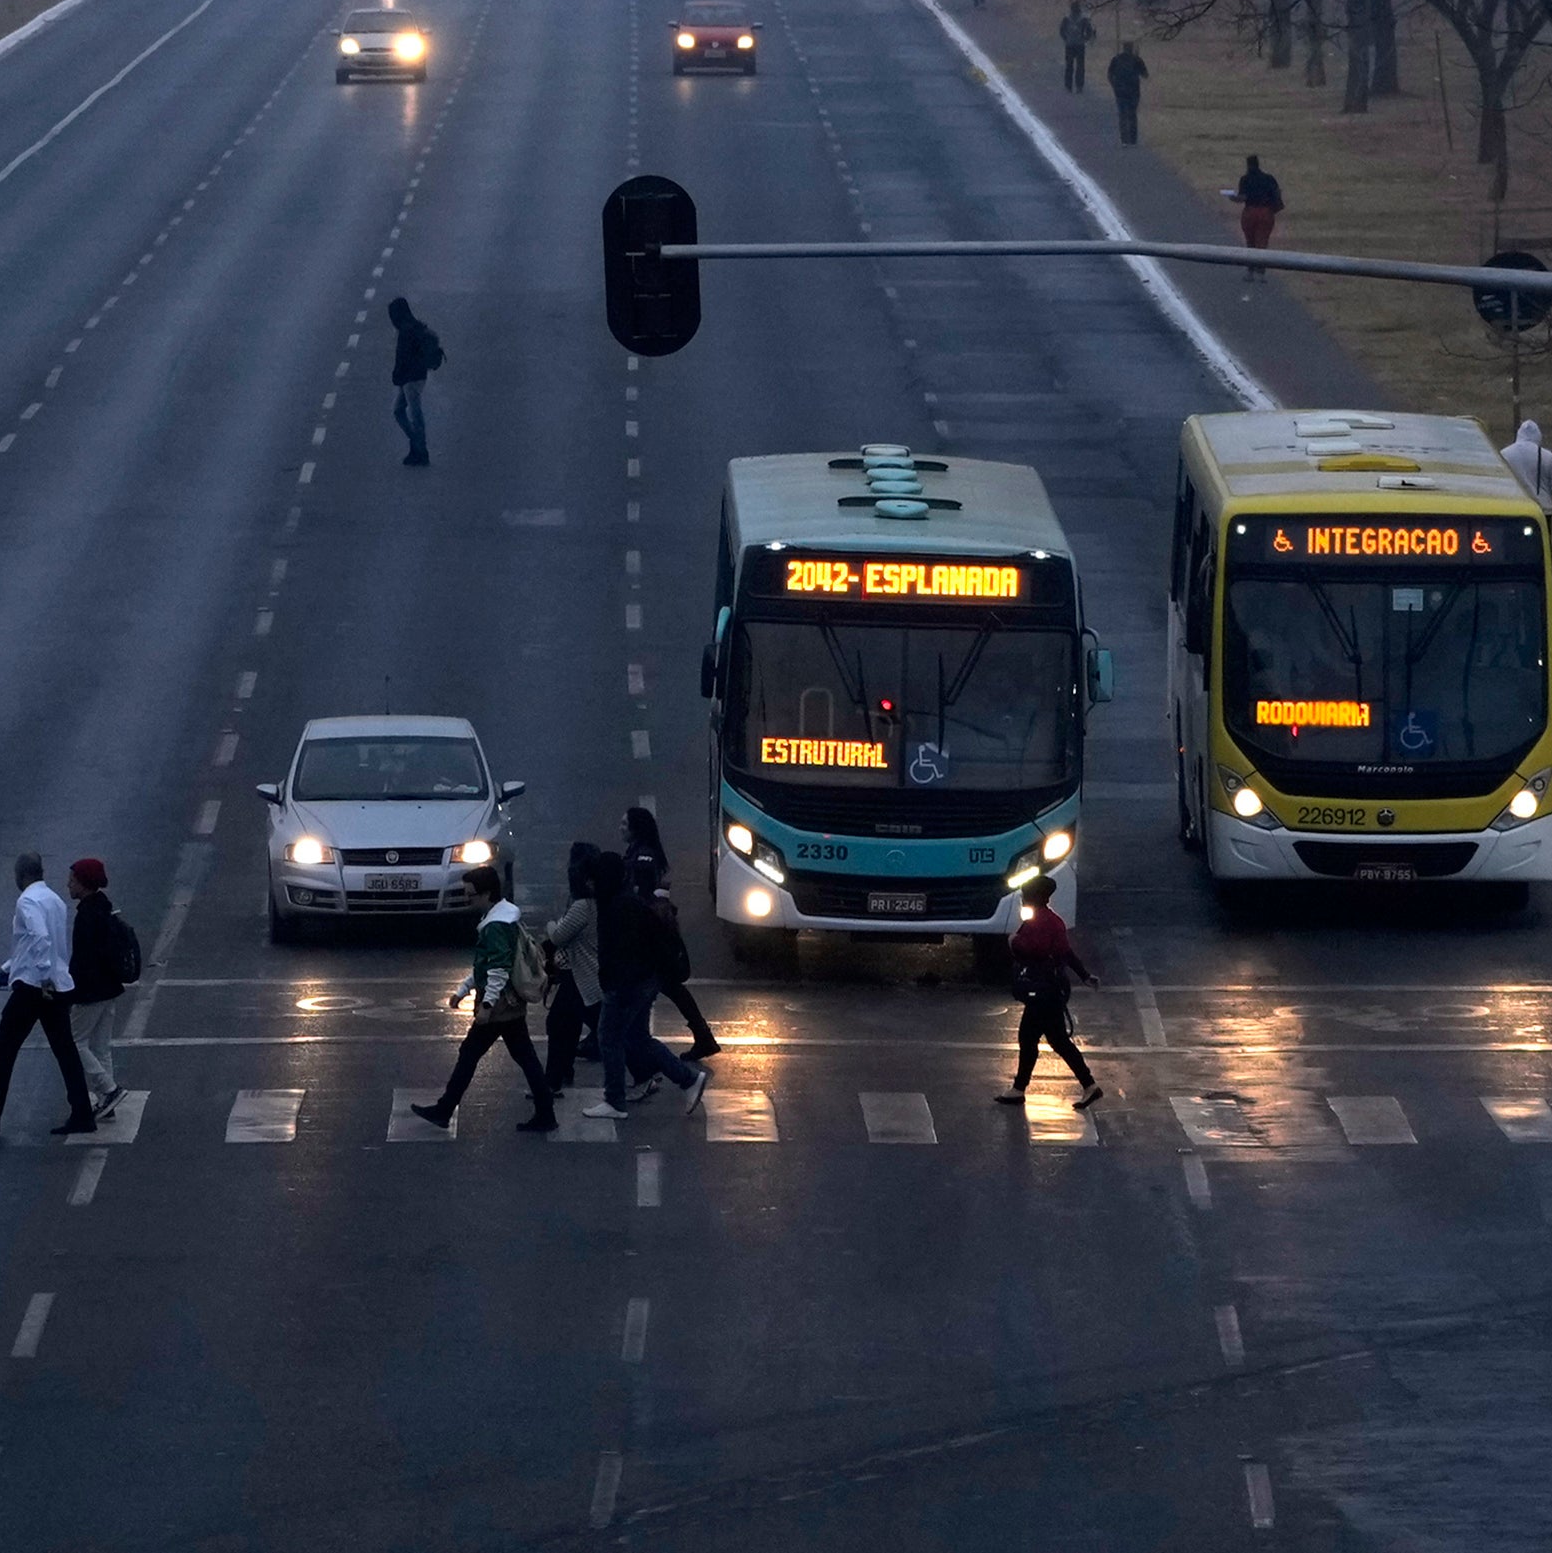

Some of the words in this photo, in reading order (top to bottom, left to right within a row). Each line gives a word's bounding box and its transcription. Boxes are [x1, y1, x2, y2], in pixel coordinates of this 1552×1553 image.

[865, 563, 1018, 597] ESPLANADA
[761, 737, 888, 768] ESTRUTURAL
[1298, 807, 1366, 826] 226912
[797, 843, 848, 861] 2330
